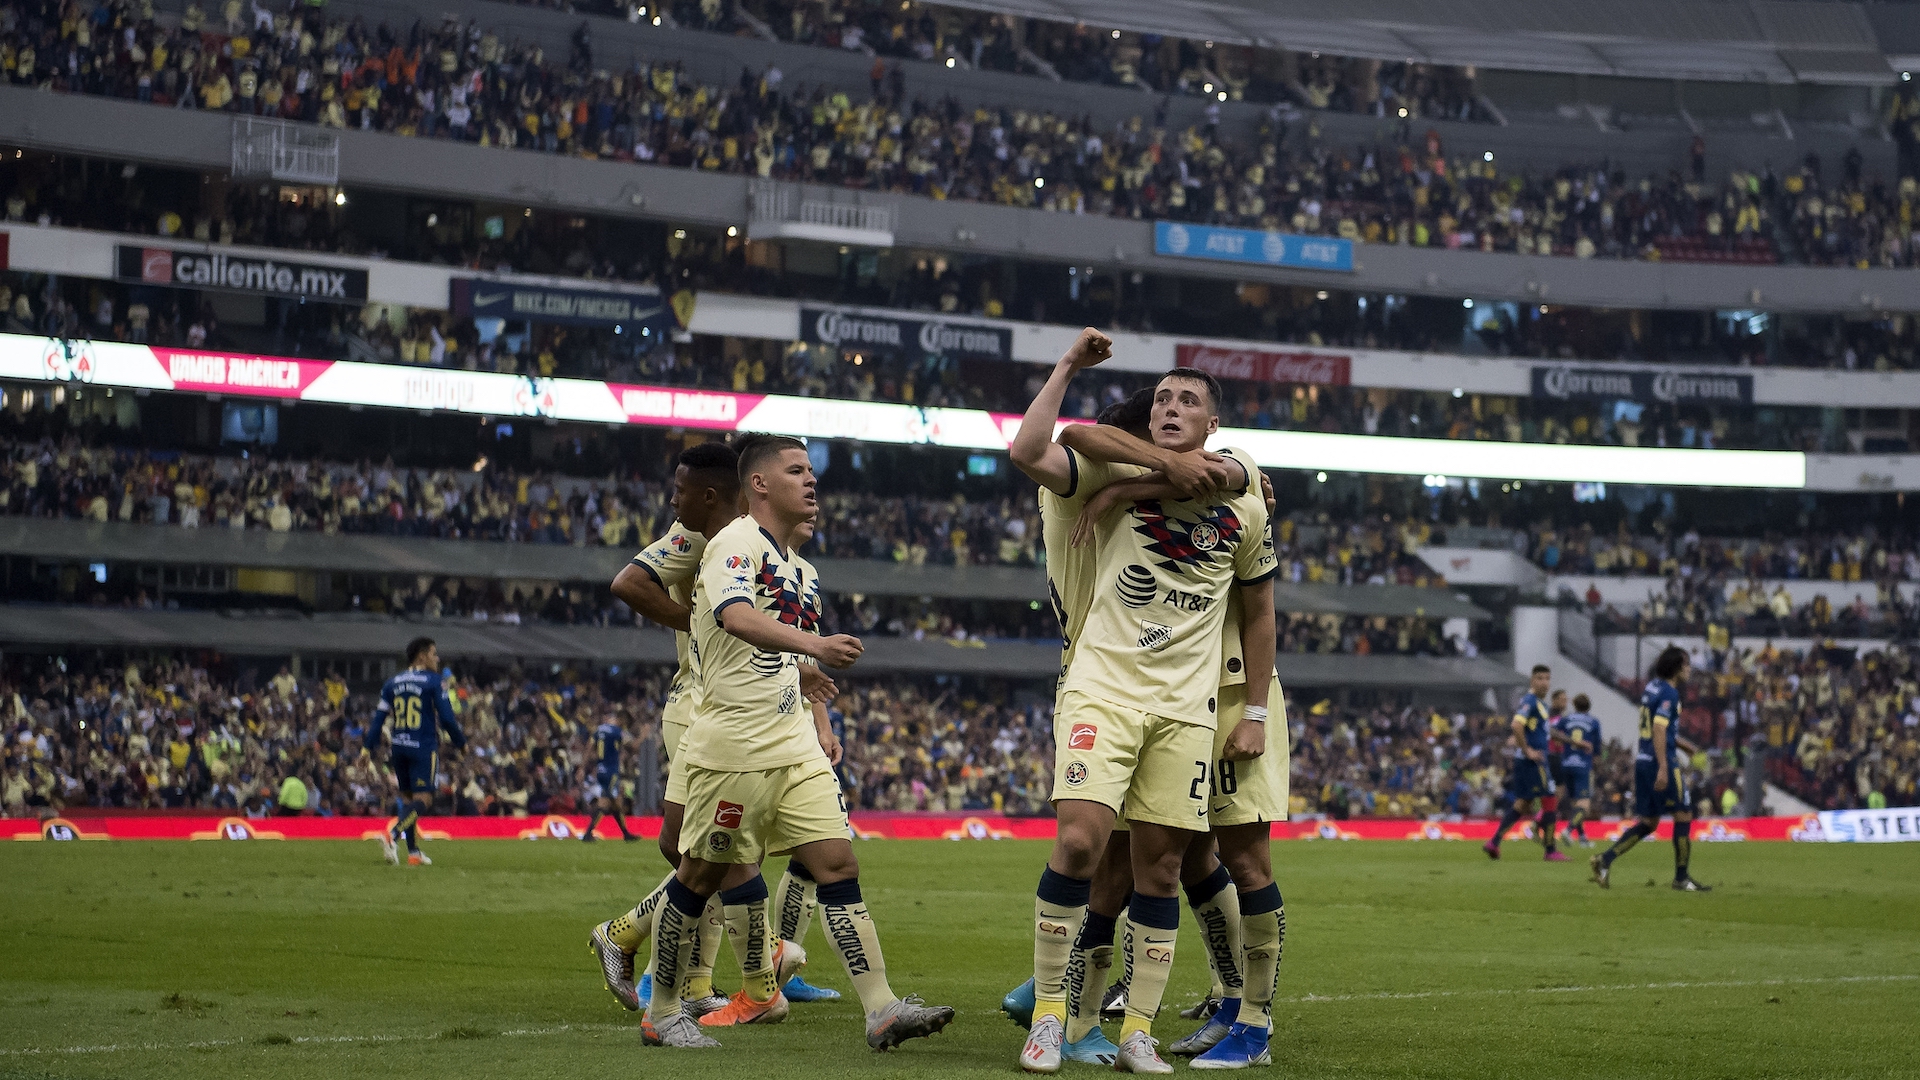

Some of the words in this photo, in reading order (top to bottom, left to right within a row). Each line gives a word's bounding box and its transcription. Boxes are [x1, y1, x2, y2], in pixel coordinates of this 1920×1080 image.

[1205, 233, 1246, 254] AT&T
[1301, 242, 1339, 263] AT&T
[175, 252, 346, 298] caliente.mx
[816, 312, 900, 344] Corona
[918, 322, 1001, 353] Corona
[168, 353, 226, 384] VAMOS
[1544, 367, 1632, 397] Corona
[1652, 371, 1739, 401] Corona
[1163, 589, 1213, 612] AT&T
[1139, 627, 1168, 648] HOME
[393, 695, 422, 730] 26
[1189, 760, 1211, 801] 2
[779, 880, 805, 940] RIDGESTONE
[1040, 921, 1067, 937] CA
[1146, 948, 1171, 964] CA
